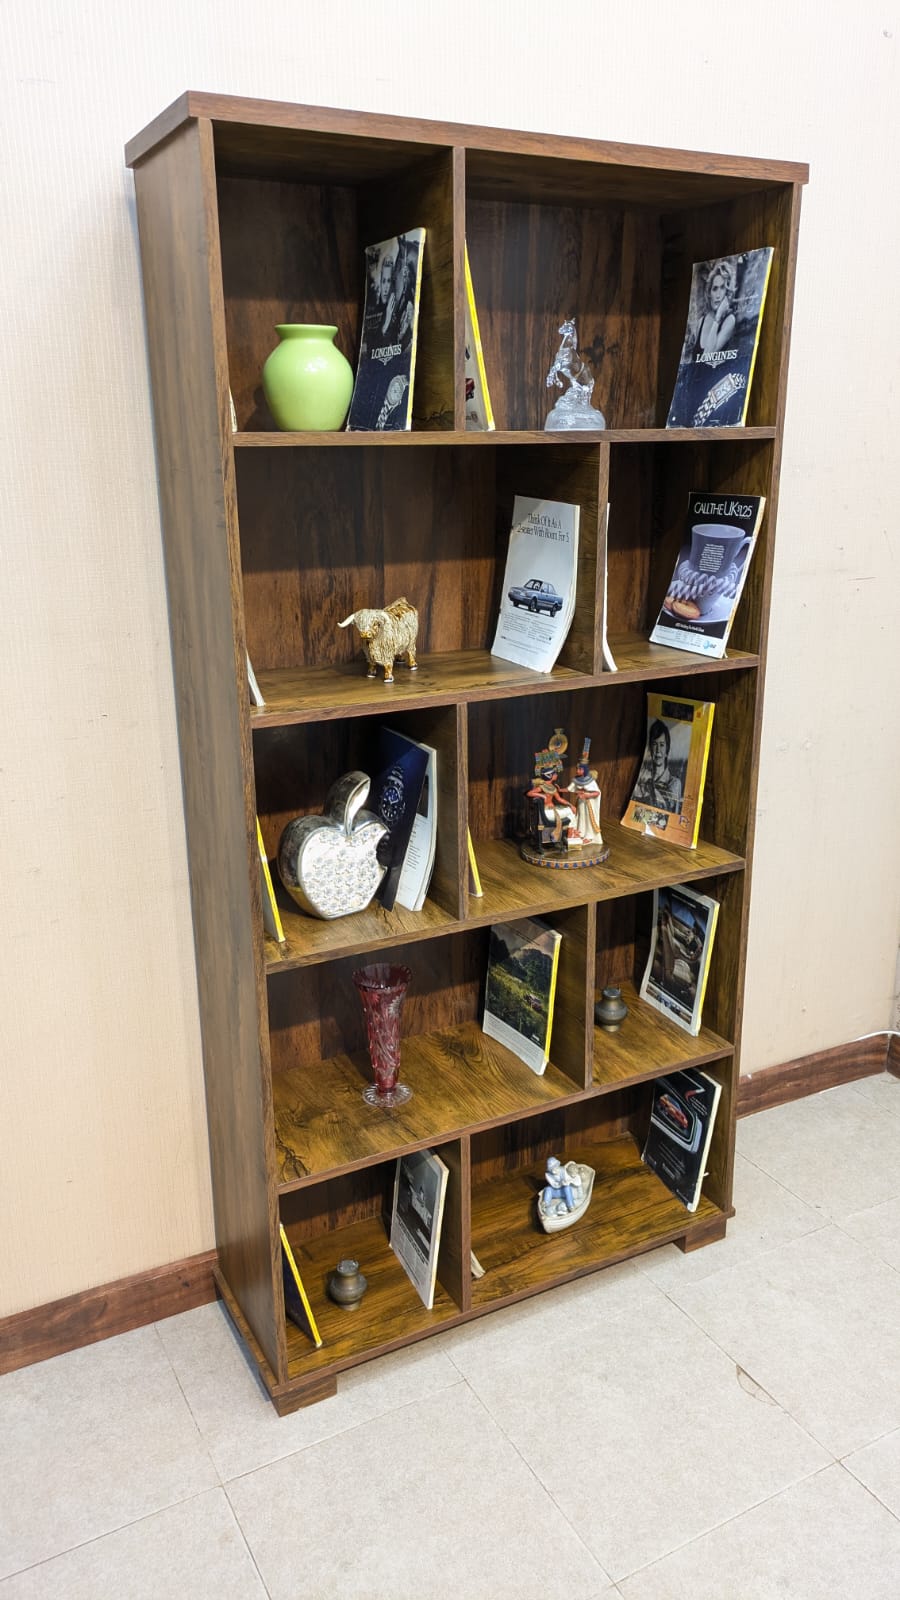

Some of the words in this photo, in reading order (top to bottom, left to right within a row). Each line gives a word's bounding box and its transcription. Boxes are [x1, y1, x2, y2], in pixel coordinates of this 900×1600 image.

[371, 344, 402, 360] LONGINES
[695, 349, 738, 363] LONGINES
[694, 502, 710, 515] CALL
[709, 502, 724, 516] THE
[723, 501, 739, 517] UK
[527, 513, 541, 525] Think
[533, 525, 545, 538] With
[545, 527, 557, 540] Room
[557, 530, 566, 542] For
[565, 531, 570, 543] 5
